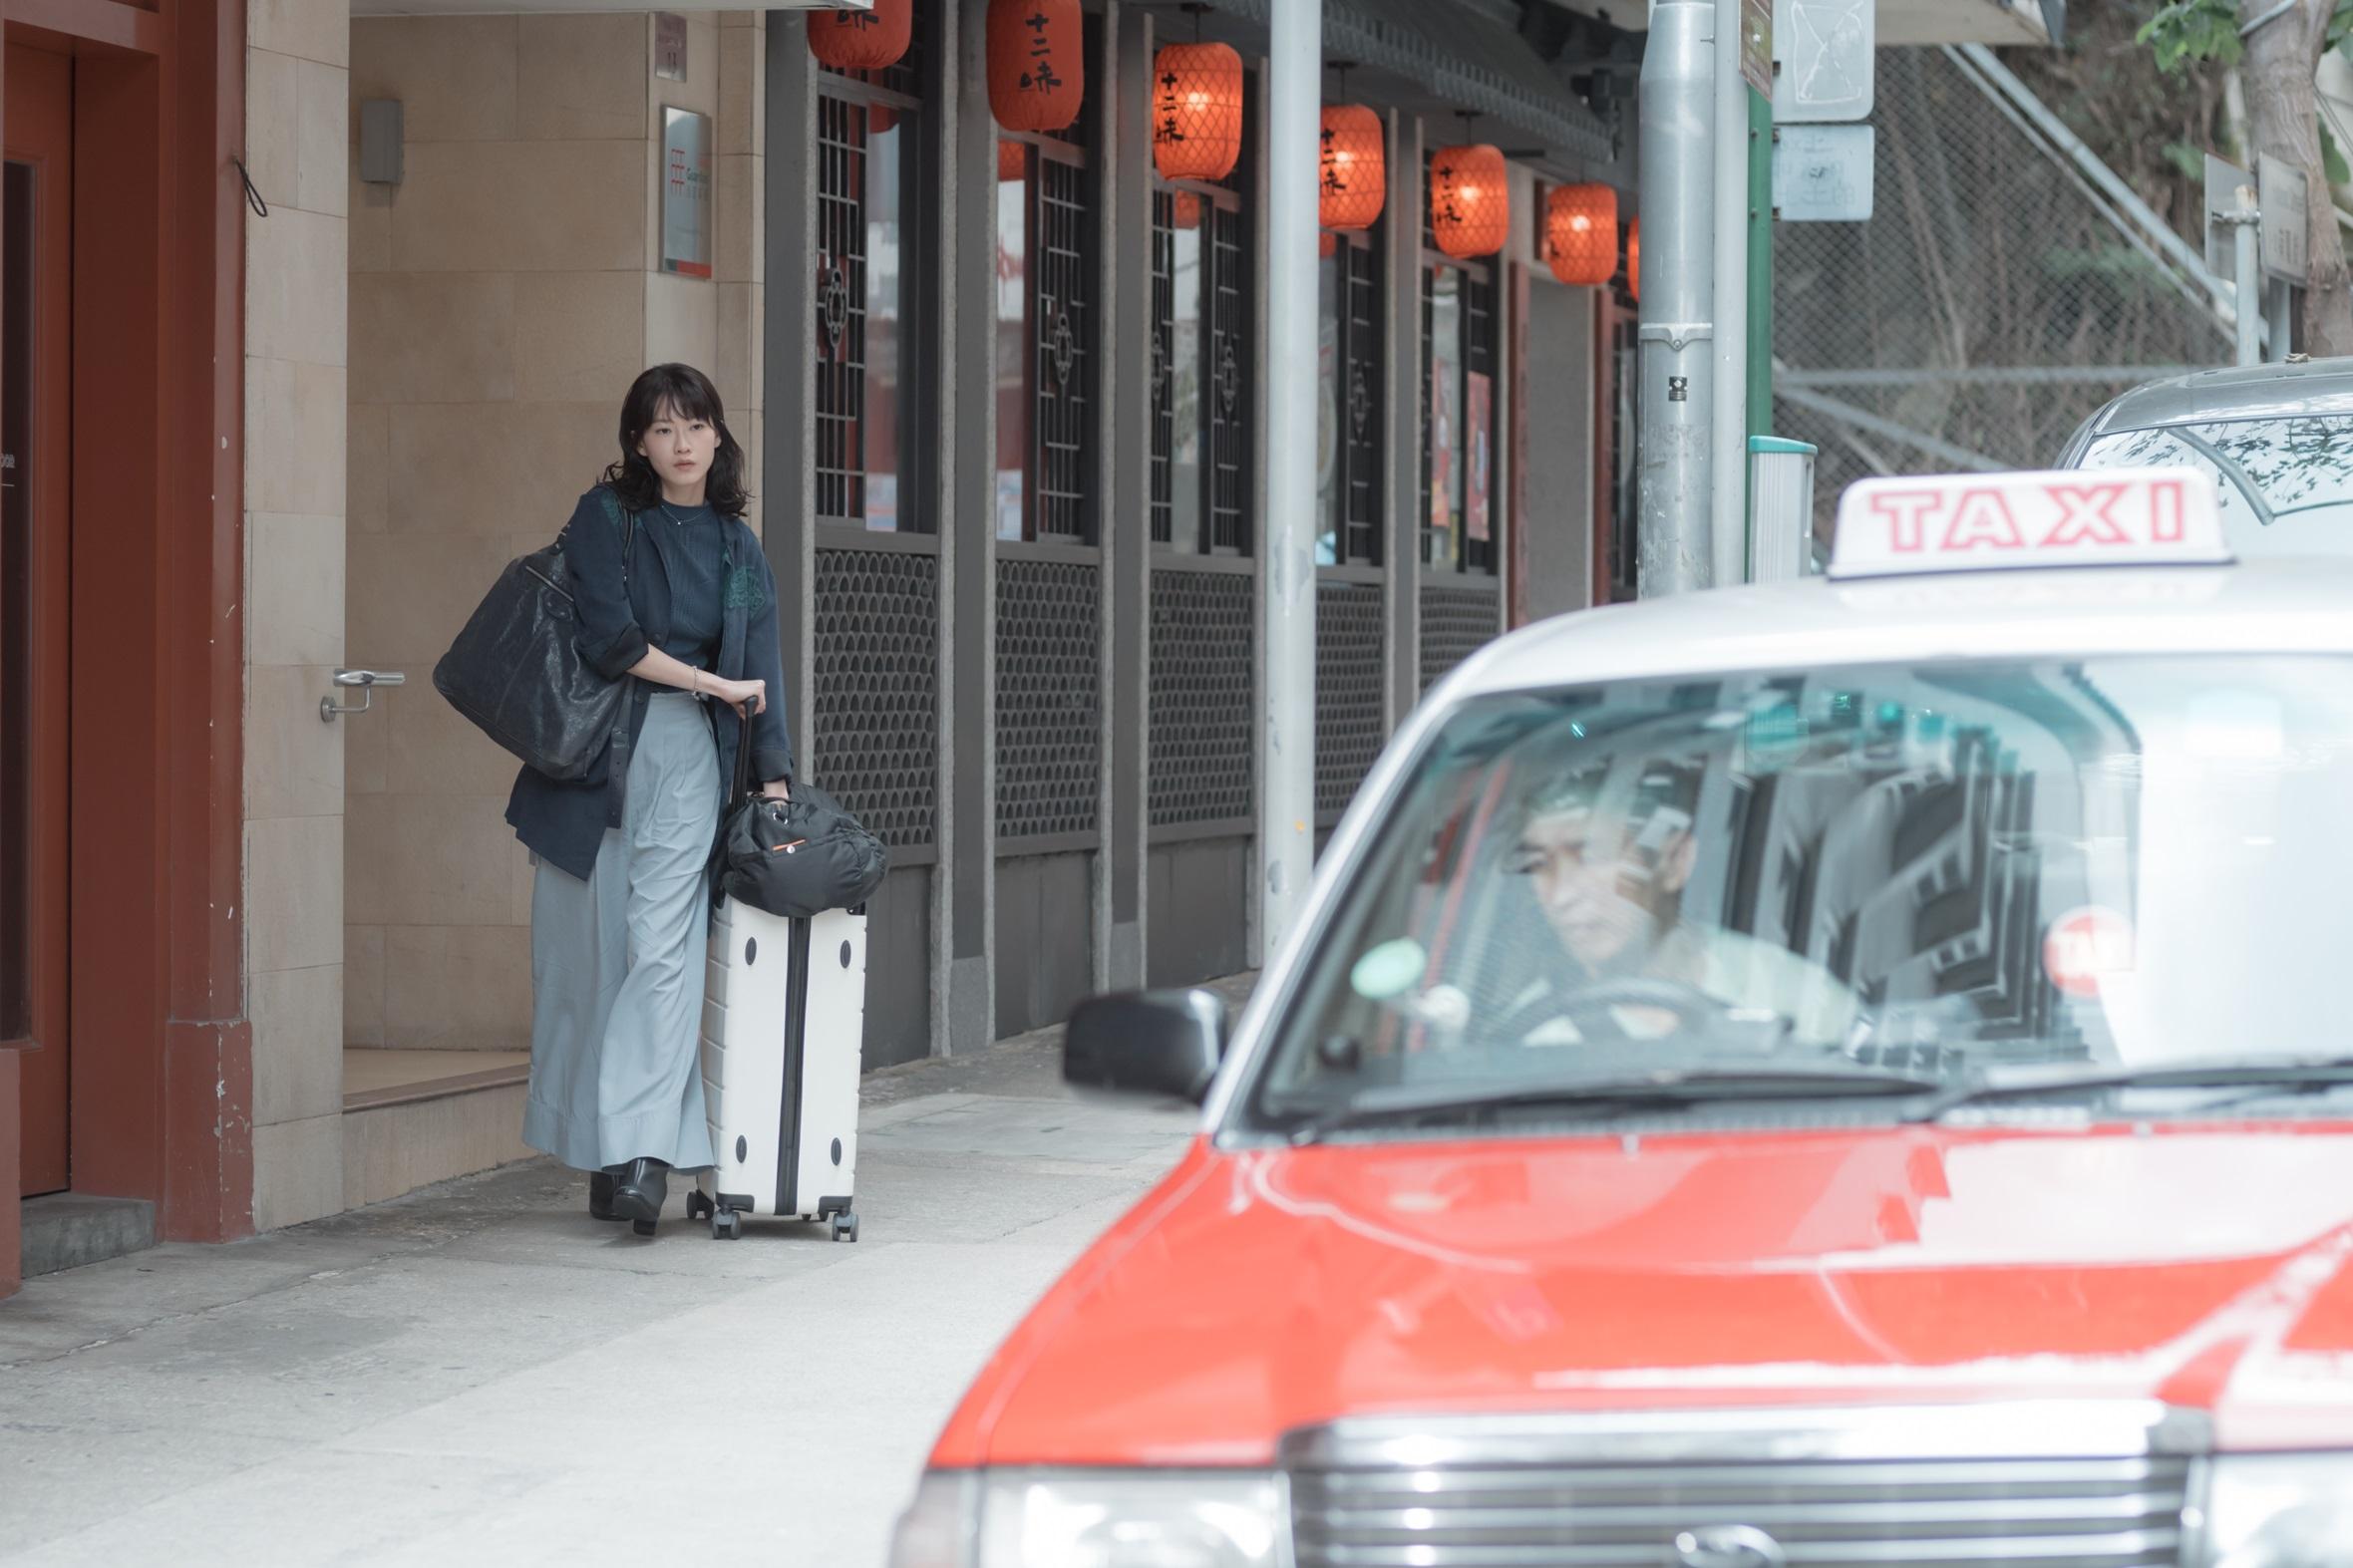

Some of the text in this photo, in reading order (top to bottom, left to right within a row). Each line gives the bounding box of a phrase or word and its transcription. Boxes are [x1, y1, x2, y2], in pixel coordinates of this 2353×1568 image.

[1019, 12, 1062, 95] 十二味
[1155, 72, 1184, 147] 十二味
[1869, 480, 2185, 552] TAXI
